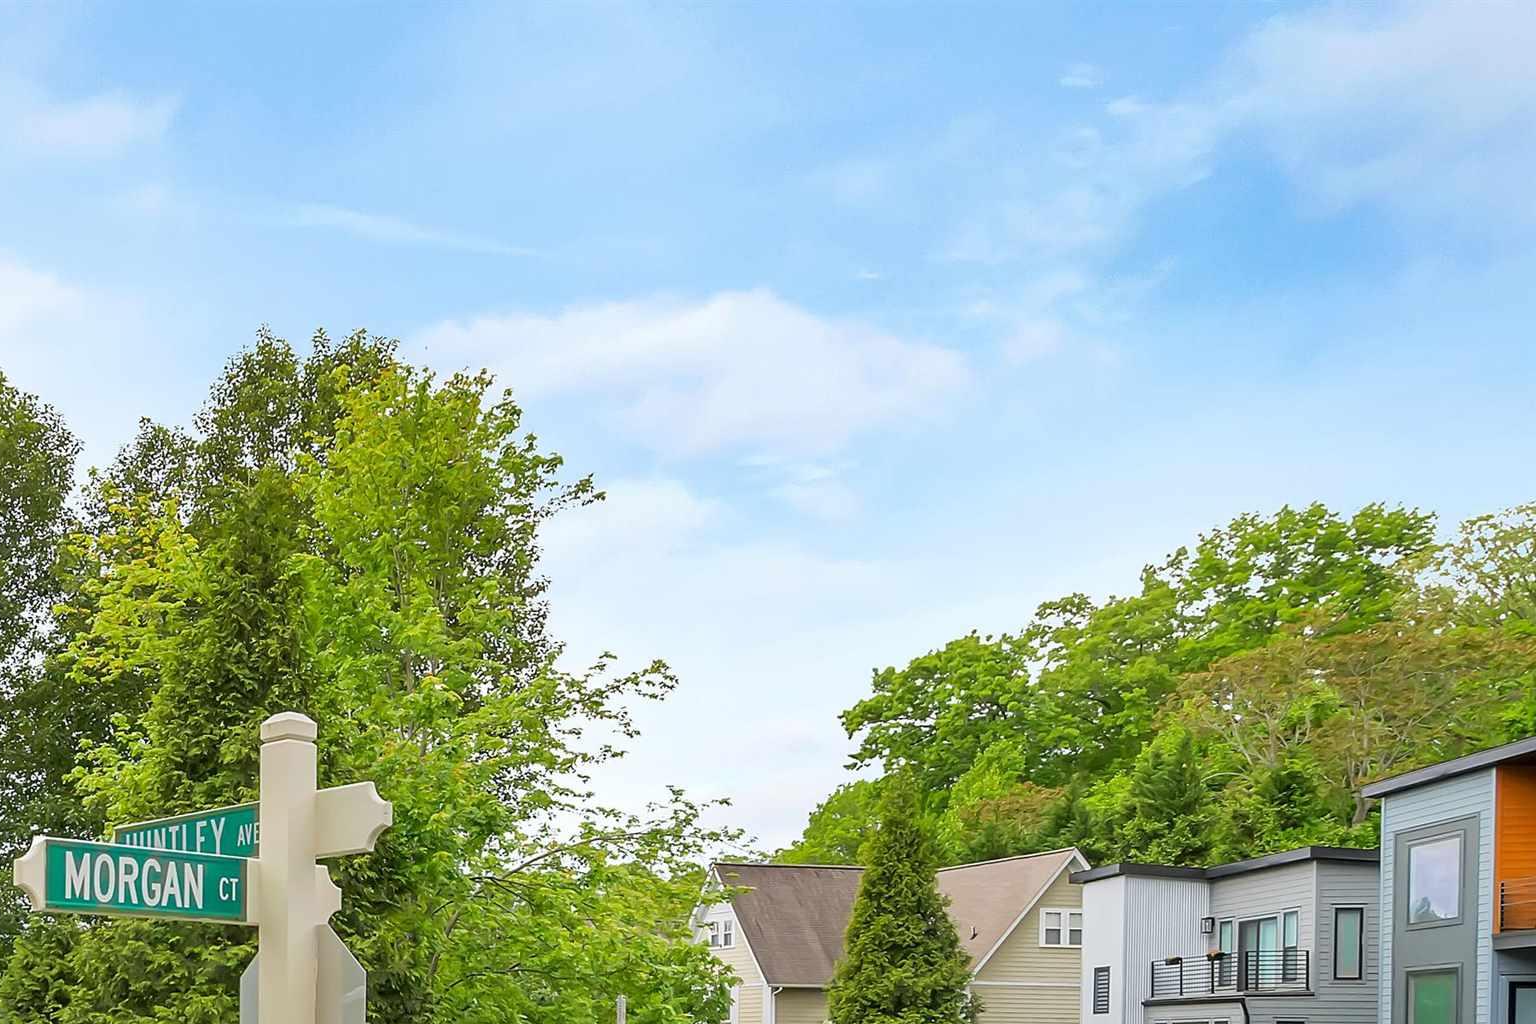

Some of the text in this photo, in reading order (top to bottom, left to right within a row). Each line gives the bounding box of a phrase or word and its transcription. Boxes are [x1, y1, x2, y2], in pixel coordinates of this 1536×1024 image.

[237, 822, 260, 847] AVE
[64, 851, 239, 909] MORGAN CT
